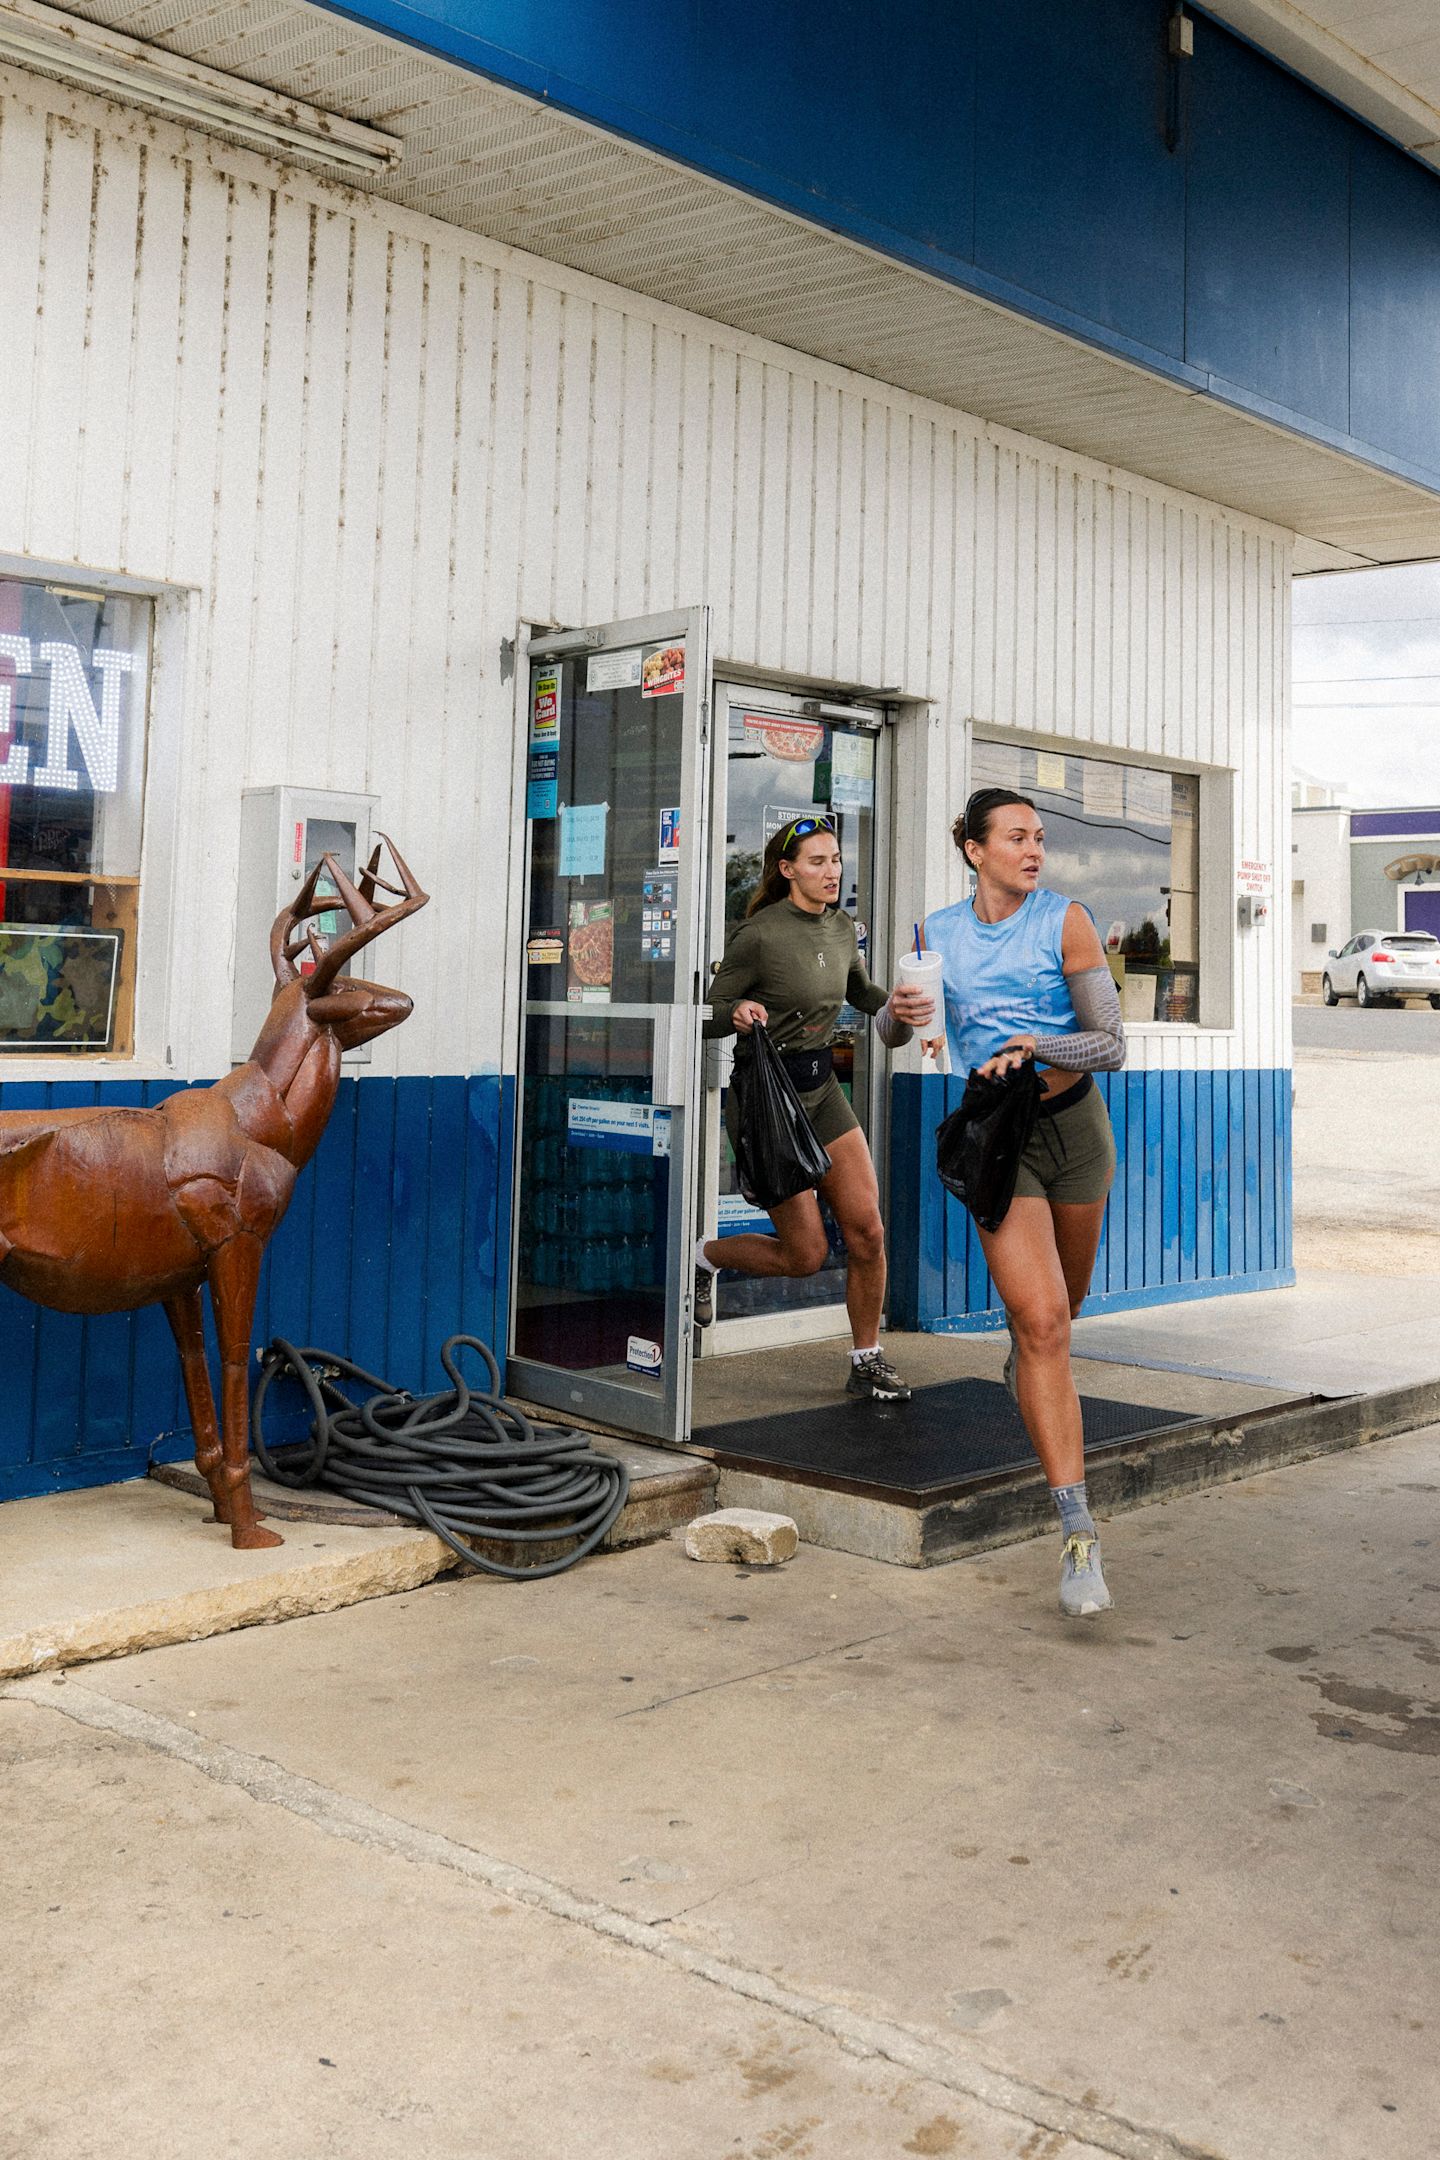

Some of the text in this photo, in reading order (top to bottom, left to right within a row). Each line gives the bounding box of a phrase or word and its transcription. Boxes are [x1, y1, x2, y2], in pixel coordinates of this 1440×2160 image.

[539, 696, 553, 709] We
[535, 704, 556, 721] Card
[1241, 861, 1266, 871] EMERGENCY
[1237, 871, 1251, 880] PUMP
[1246, 882, 1263, 892] SWITCH
[630, 1346, 653, 1360] Protection
